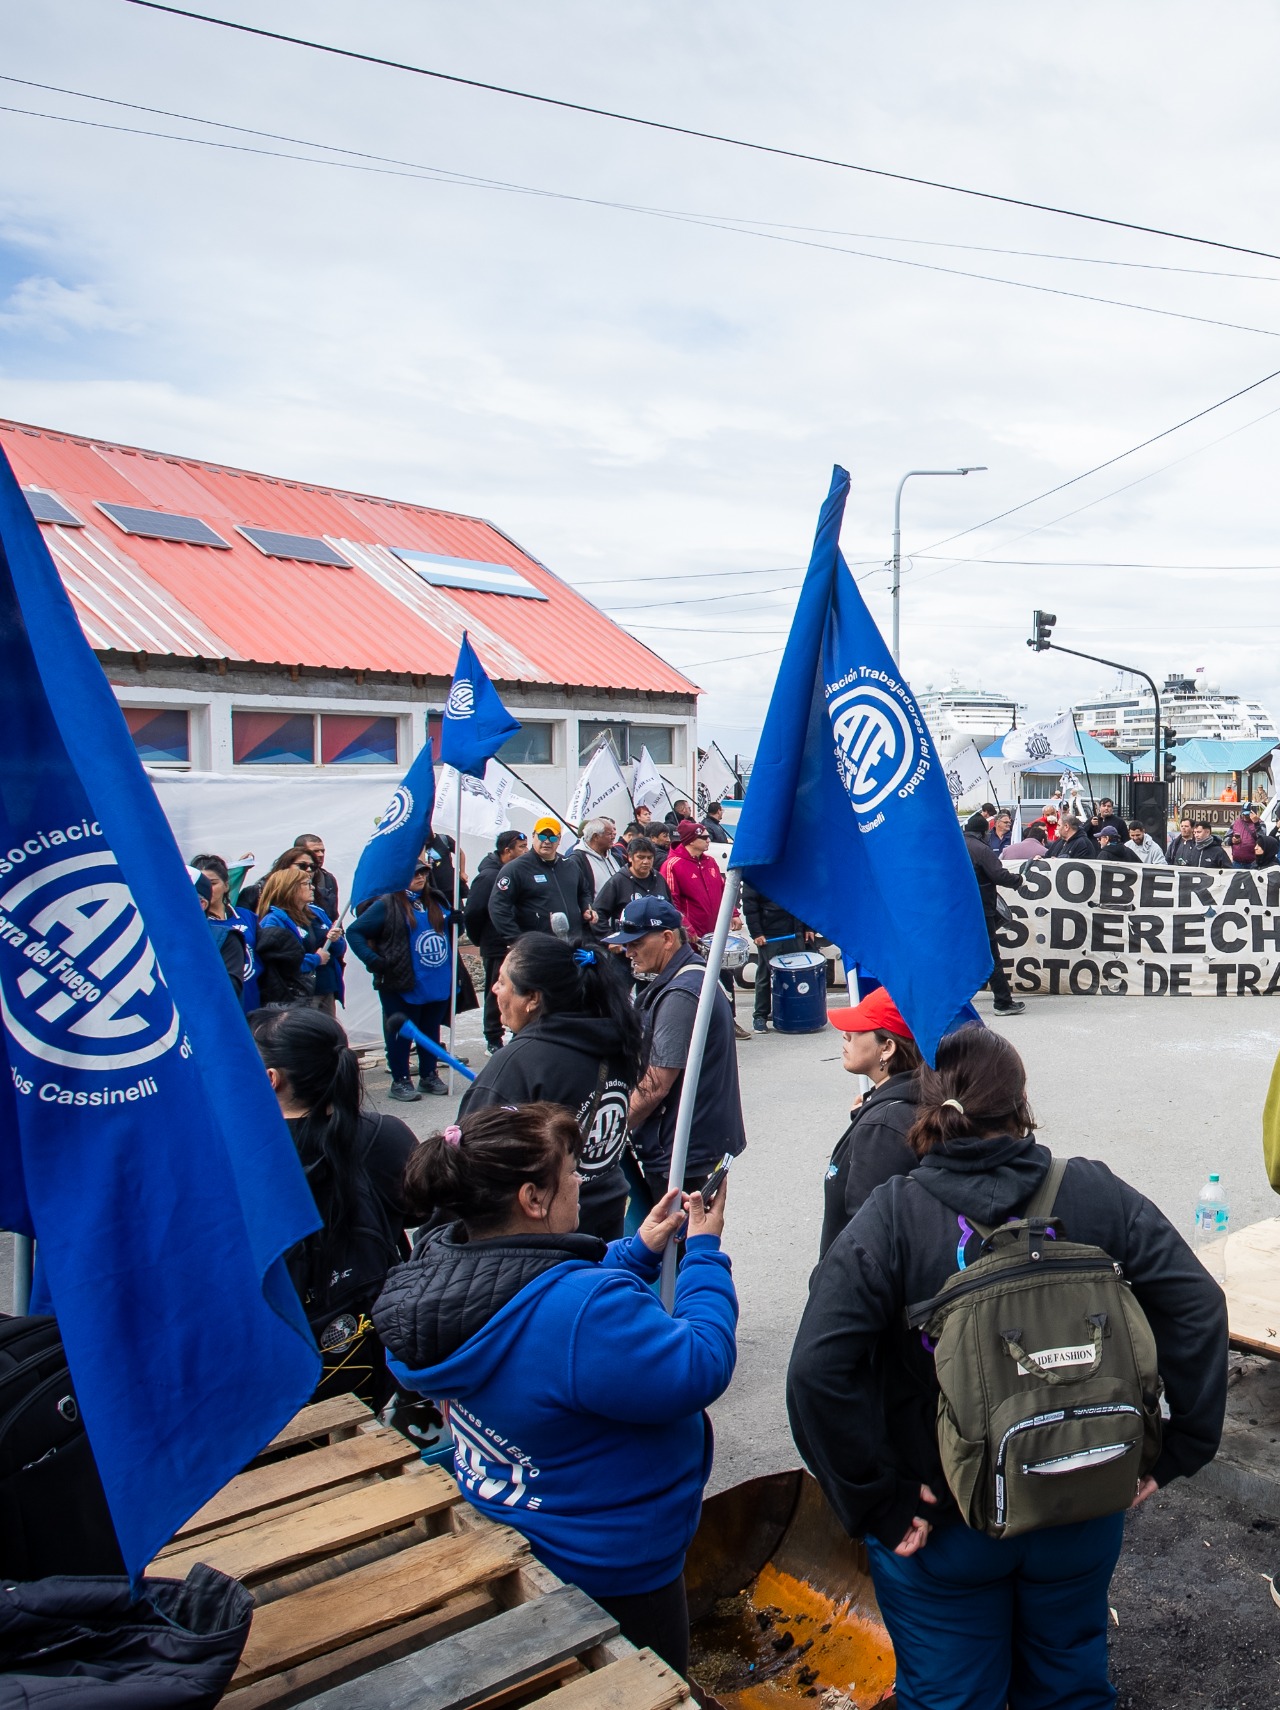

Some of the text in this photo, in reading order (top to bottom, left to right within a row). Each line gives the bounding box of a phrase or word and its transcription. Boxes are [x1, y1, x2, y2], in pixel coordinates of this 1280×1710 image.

[859, 666, 925, 734] Trabajadores
[833, 704, 896, 796] ATE
[919, 737, 931, 759] del
[897, 761, 931, 799] Estado
[1184, 809, 1240, 823] PUERTO USH
[23, 938, 51, 967] del
[50, 956, 101, 1003] Fuego
[1143, 962, 1193, 996] DE
[39, 1077, 158, 1106] Cassinelli
[585, 1103, 625, 1155] ATE
[1034, 1349, 1093, 1366] IDE FASHION
[484, 1427, 509, 1446] del
